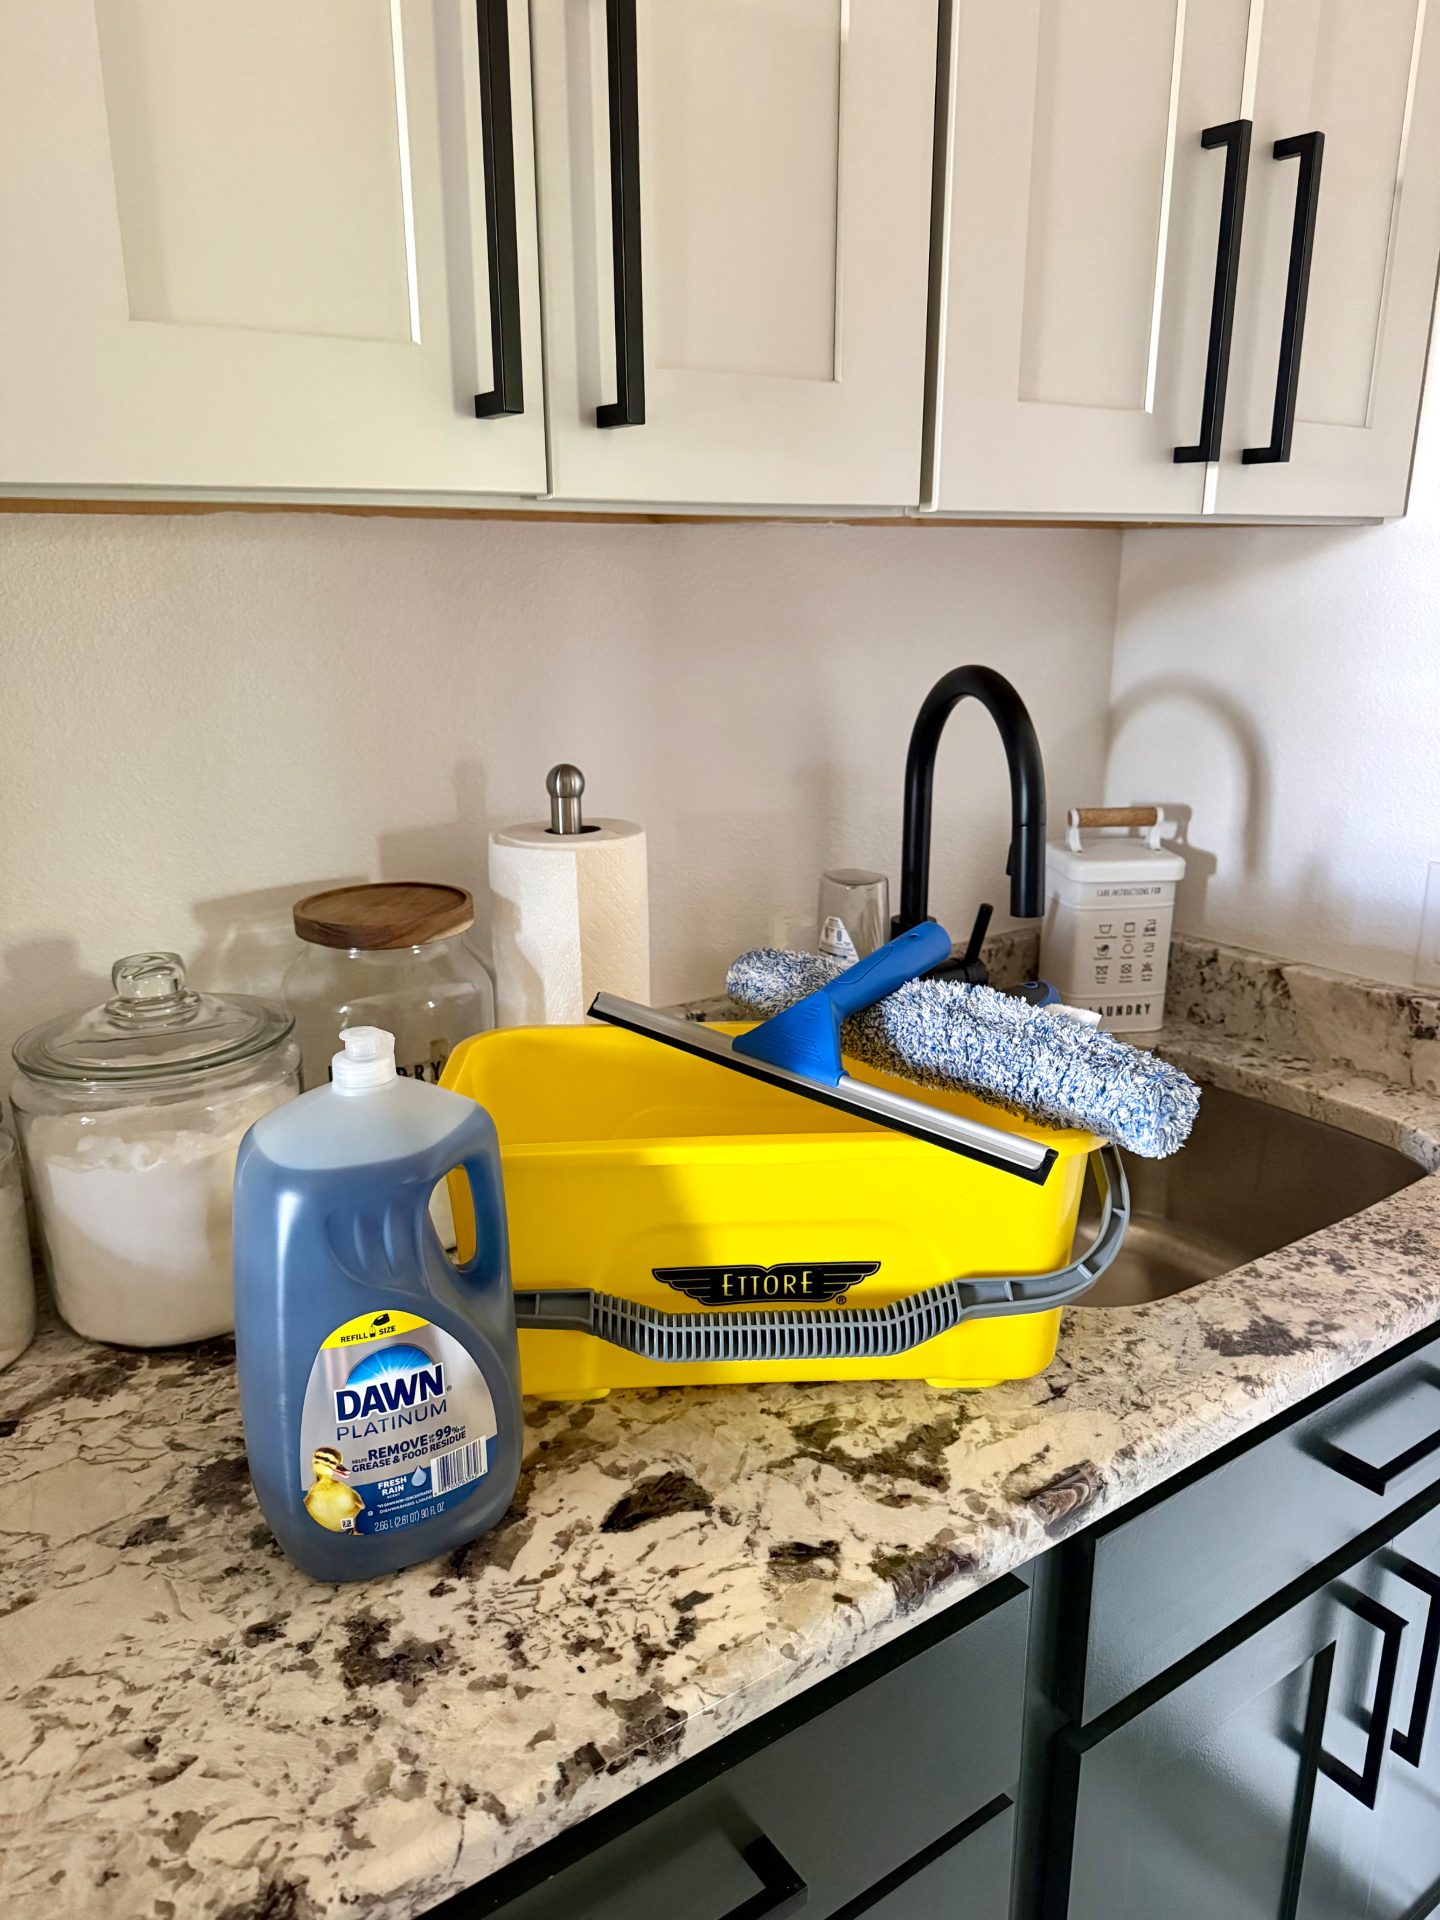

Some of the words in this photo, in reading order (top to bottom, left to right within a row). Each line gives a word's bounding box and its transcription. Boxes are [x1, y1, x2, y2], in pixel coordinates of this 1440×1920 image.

[1096, 889, 1110, 897] CARE
[1112, 887, 1149, 896] INSTRUCTIONS
[1151, 887, 1161, 895] FOR
[1089, 1003, 1151, 1017] AUNDRY
[722, 1271, 812, 1296] ETTORE
[340, 1332, 368, 1343] REFILL
[378, 1325, 396, 1335] SIZE
[336, 1364, 444, 1421] DAWN
[336, 1399, 447, 1441] PLATINUM
[351, 1458, 391, 1473] GREASE
[392, 1455, 400, 1464] &
[402, 1446, 429, 1461] FOOD
[430, 1430, 467, 1452] RESIDUE
[368, 1434, 429, 1461] REMOVE
[378, 1475, 407, 1489] FRESH
[382, 1484, 404, 1496] RAIN
[421, 1508, 429, 1519] 90
[430, 1505, 436, 1516] FL
[437, 1501, 445, 1513] OZ
